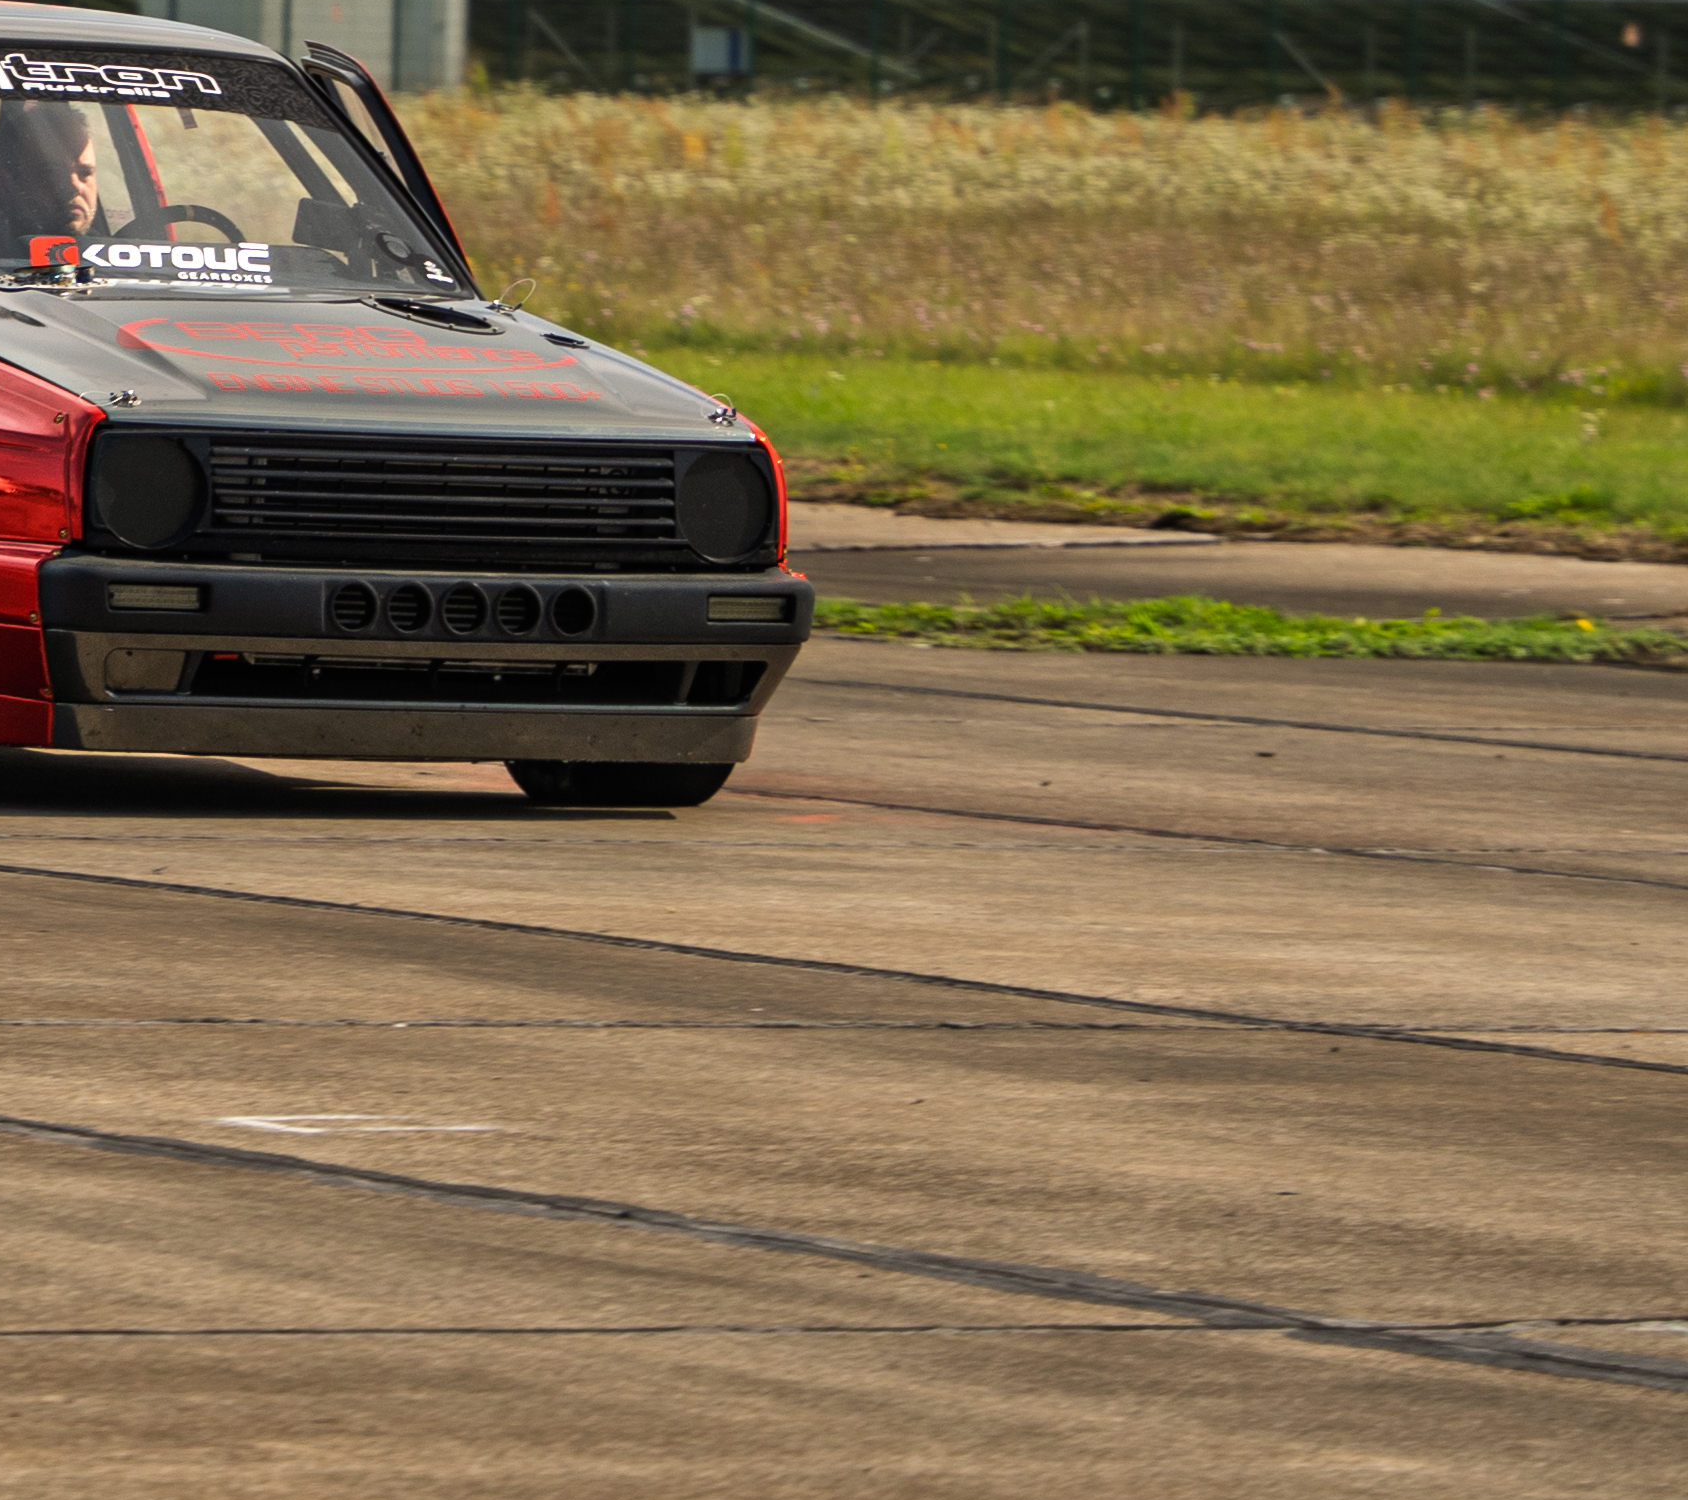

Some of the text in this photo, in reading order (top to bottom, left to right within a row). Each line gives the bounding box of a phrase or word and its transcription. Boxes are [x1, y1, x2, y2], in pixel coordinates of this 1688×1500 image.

[22, 82, 171, 98] Australia
[177, 271, 273, 284] GEARBOXES
[173, 321, 428, 349] BERG
[205, 371, 358, 395] ENGINE
[352, 375, 485, 398] STUDS
